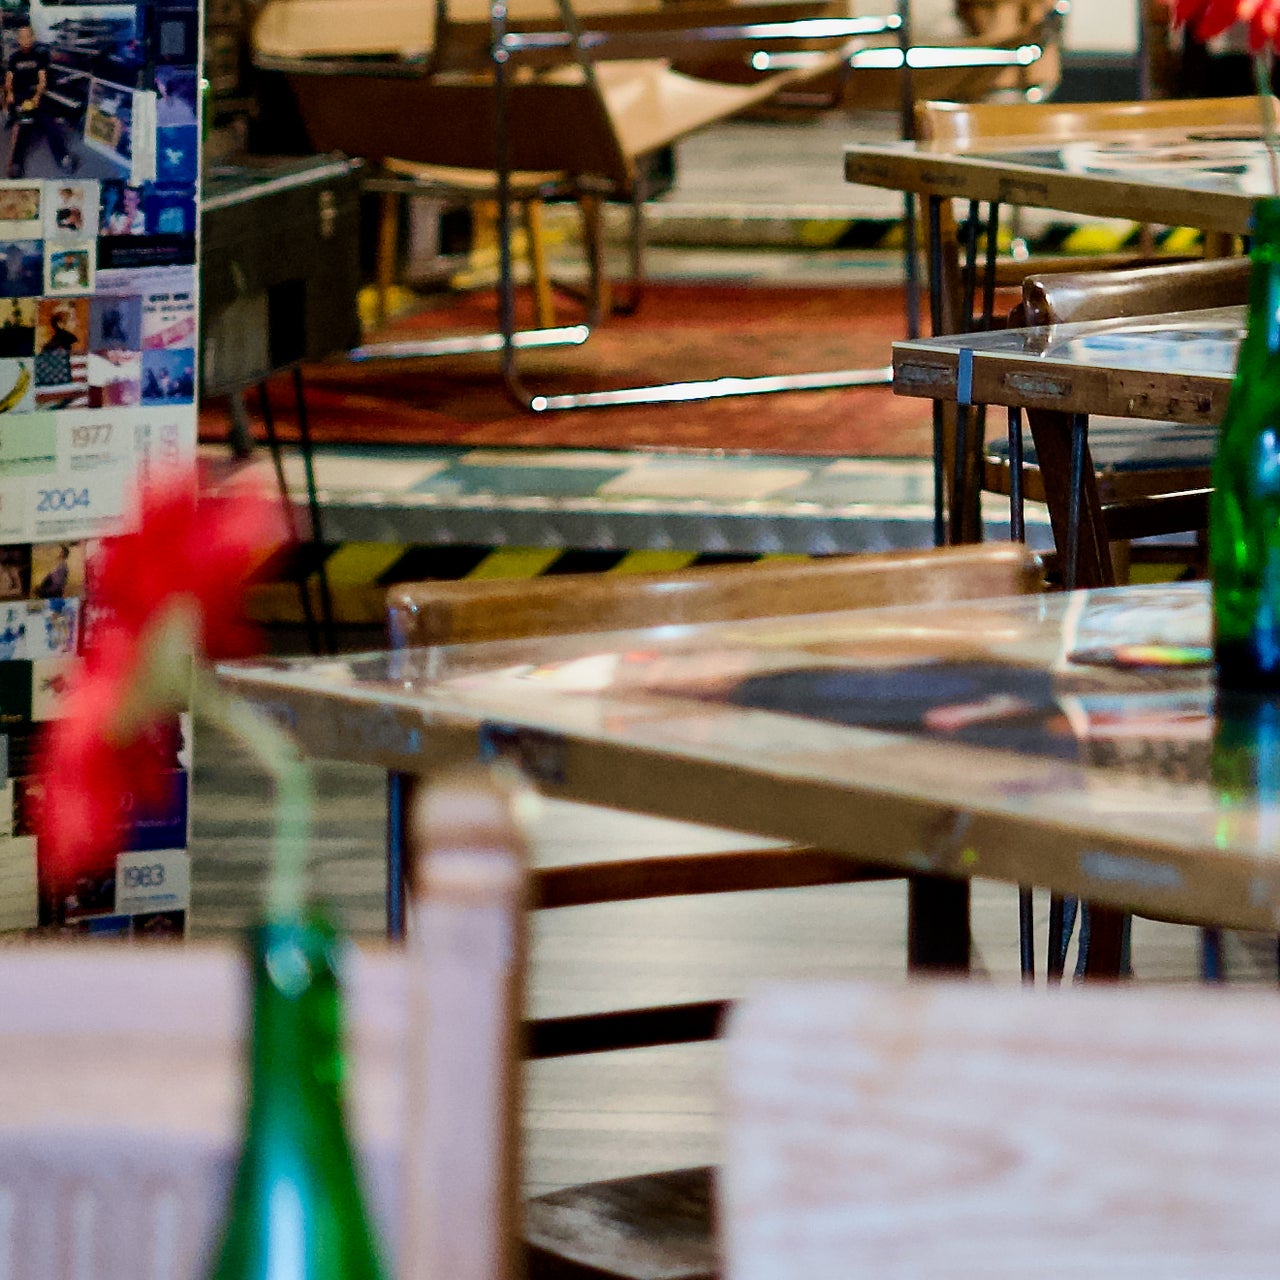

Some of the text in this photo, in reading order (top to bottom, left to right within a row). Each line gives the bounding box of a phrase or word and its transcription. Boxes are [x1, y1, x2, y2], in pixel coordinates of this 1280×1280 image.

[71, 423, 113, 448] 1977
[36, 487, 91, 513] 2004
[123, 863, 166, 889] 1983
